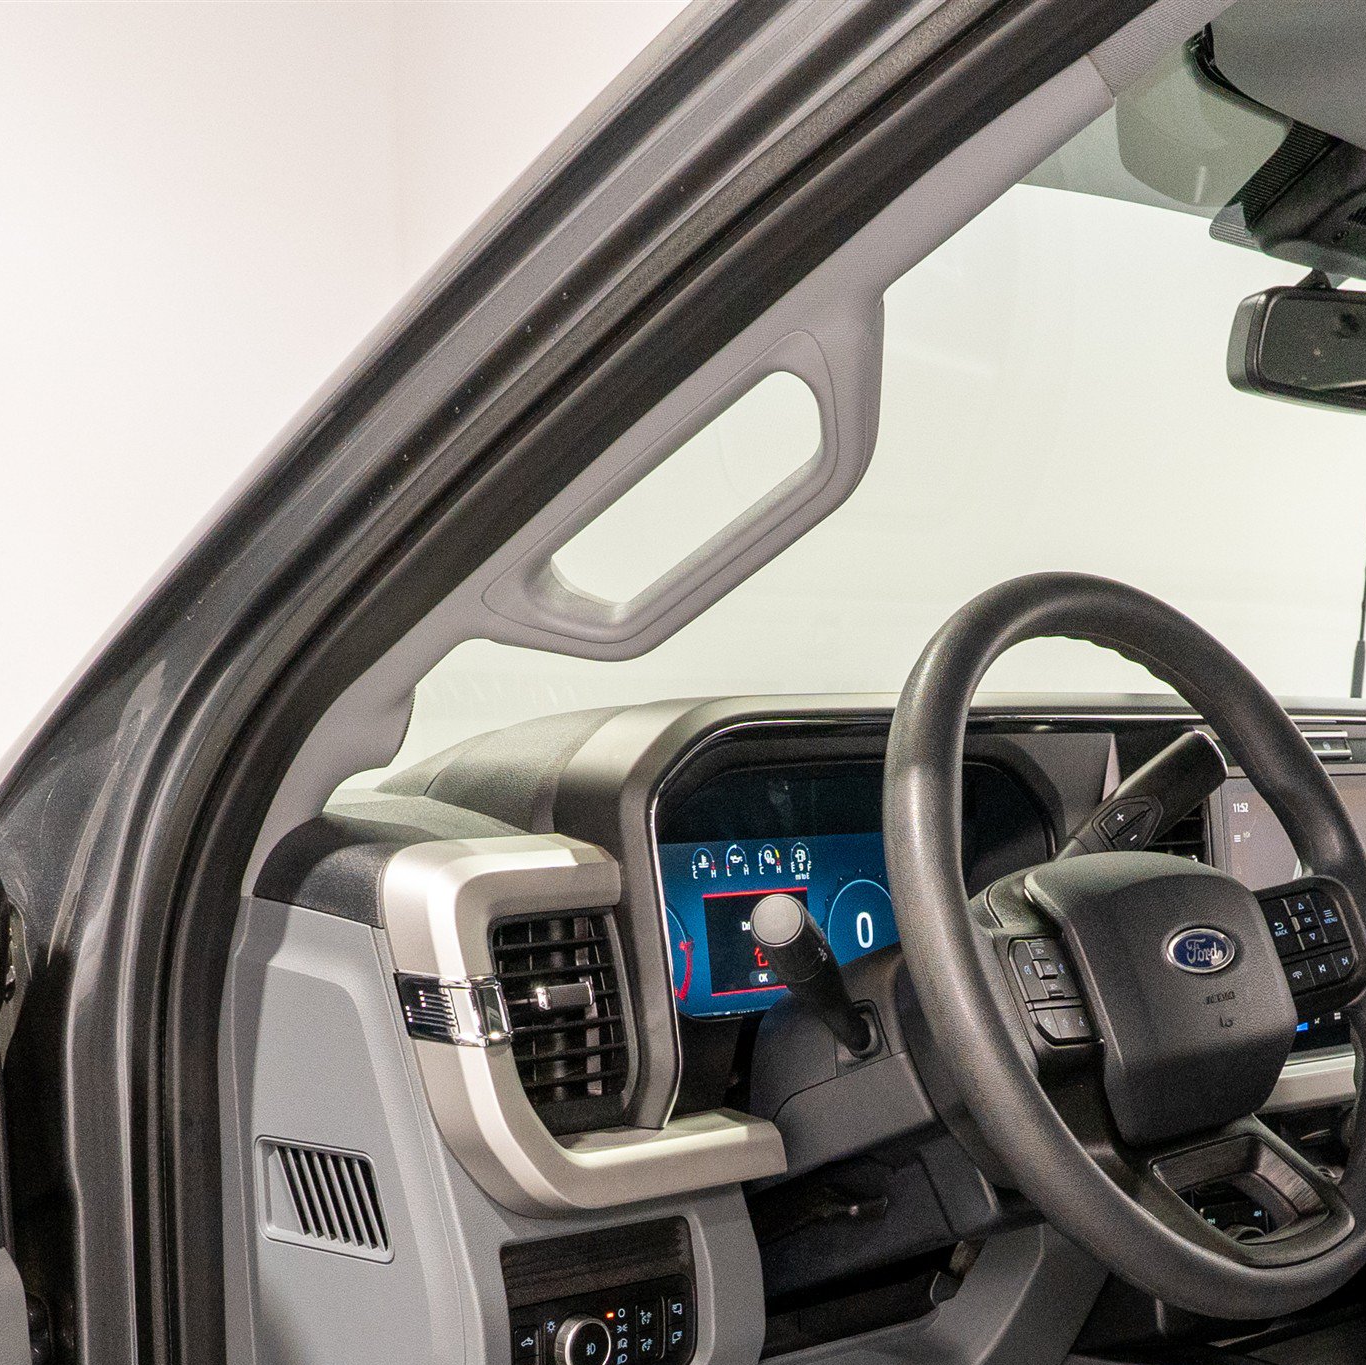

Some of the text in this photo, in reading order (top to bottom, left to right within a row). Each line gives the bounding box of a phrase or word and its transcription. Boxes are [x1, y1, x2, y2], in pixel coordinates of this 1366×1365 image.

[856, 911, 874, 949] 0
[1274, 929, 1288, 937] BACK
[1185, 938, 1223, 964] Ford
[758, 973, 769, 982] OK
